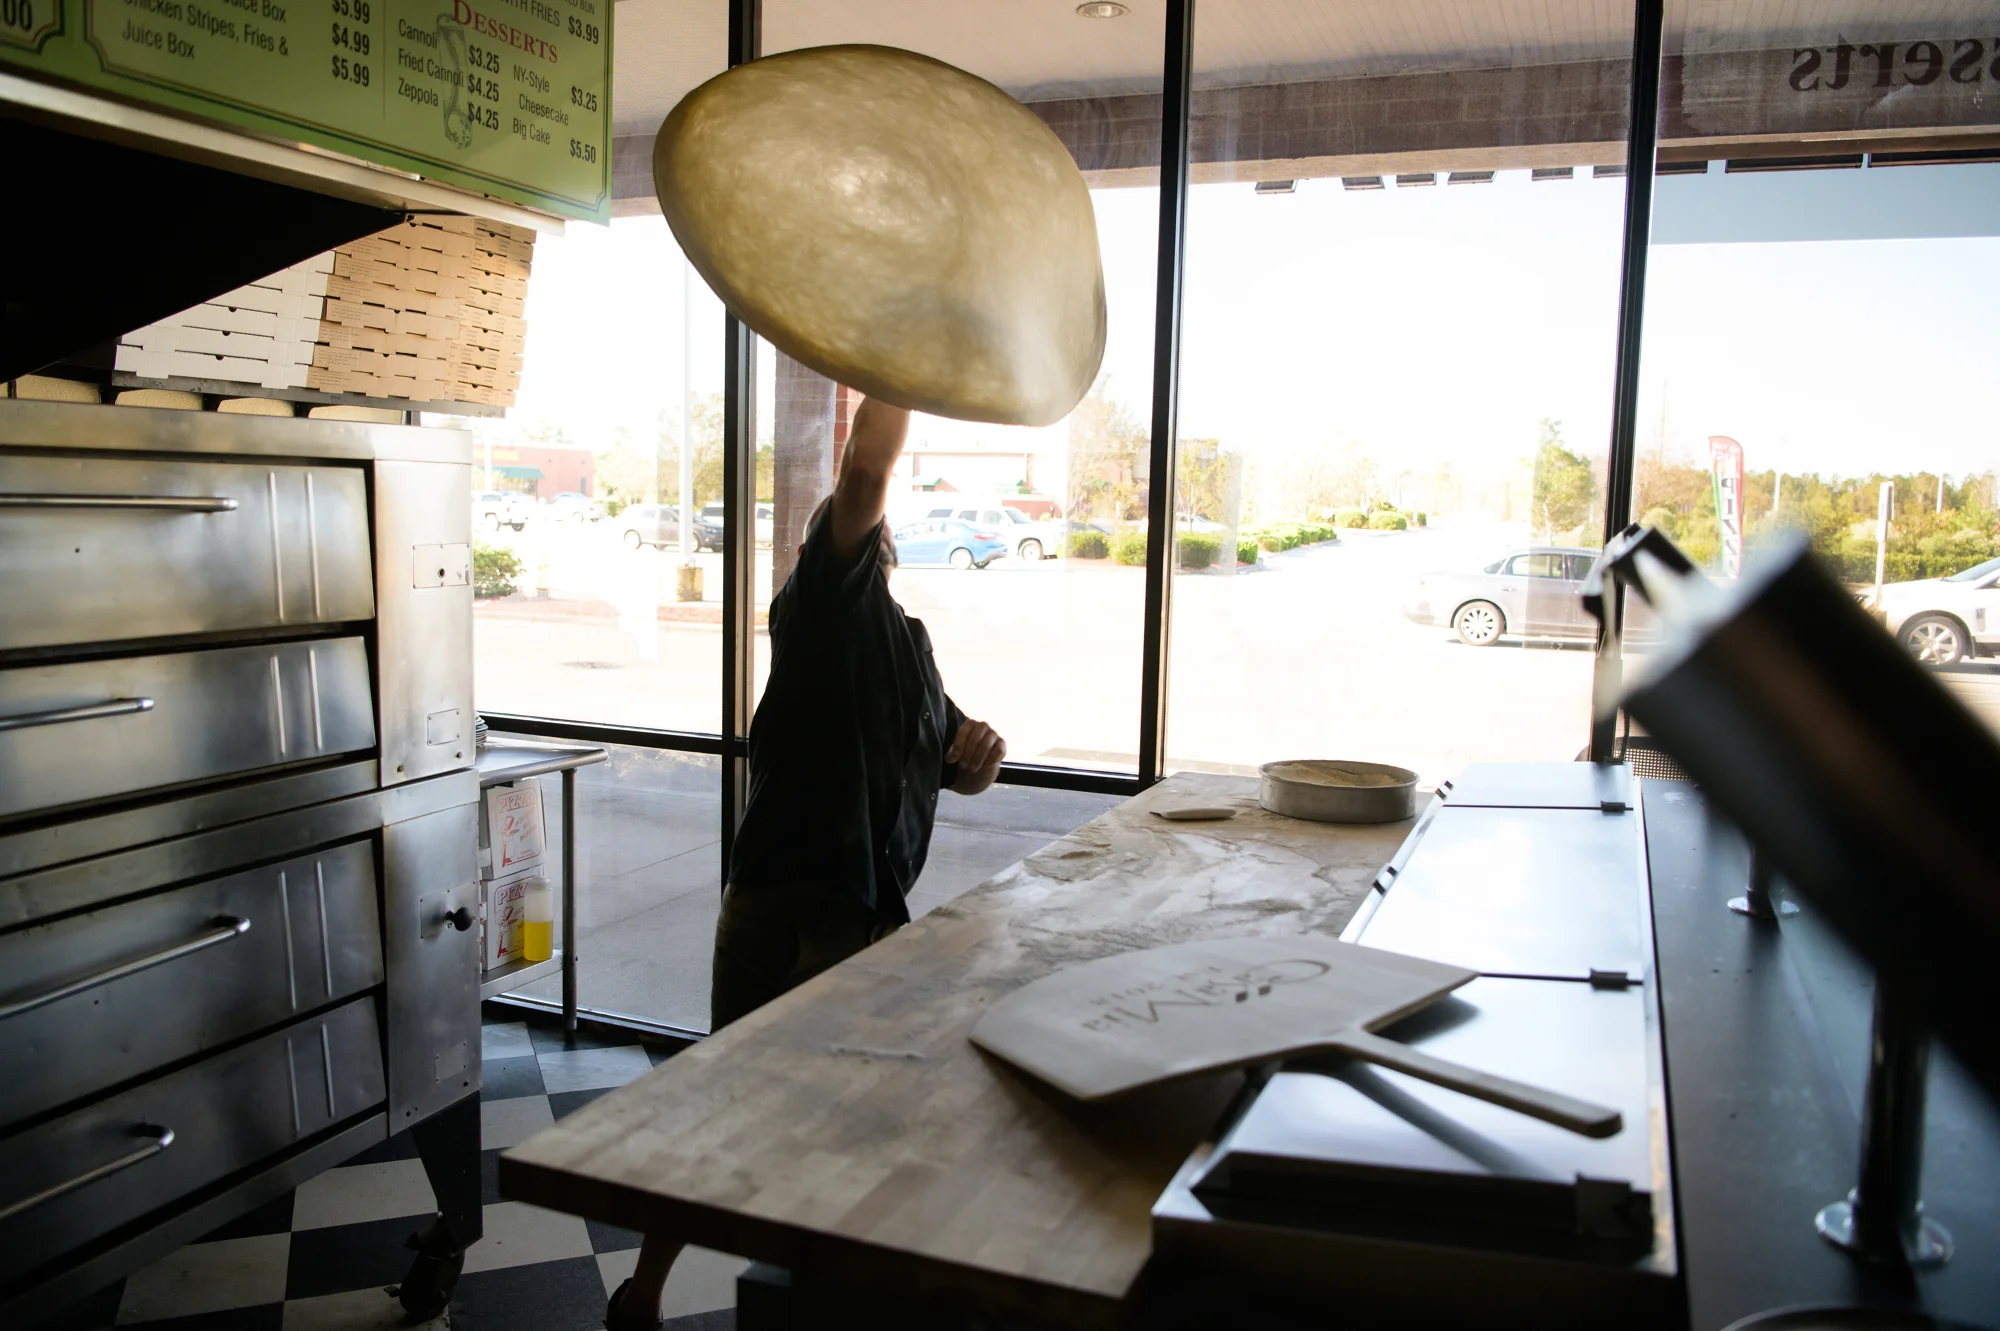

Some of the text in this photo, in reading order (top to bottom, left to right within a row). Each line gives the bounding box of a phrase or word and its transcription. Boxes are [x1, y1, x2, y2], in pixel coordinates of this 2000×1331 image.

[223, 0, 287, 23] ice Box
[332, 0, 370, 24] $5.99
[531, 0, 560, 27] FRIES
[580, 0, 595, 15] BUN
[122, 18, 195, 60] Juice Box
[187, 4, 239, 43] Stripes,
[244, 23, 275, 52] Fries
[279, 36, 288, 56] &
[332, 22, 370, 56] $4.99
[398, 18, 438, 49] Cannoli
[453, 0, 558, 64] DESSERTS
[568, 15, 600, 45] $3.99
[332, 54, 370, 87] $5.99
[398, 48, 464, 88] Fried Cannoli
[469, 44, 500, 74] $3.25
[398, 77, 439, 107] Zeppola
[468, 73, 499, 102] $4.25
[513, 64, 550, 93] NY-Style
[519, 93, 569, 126] Cheesecake
[571, 85, 597, 112] $3.25
[467, 101, 499, 131] $4.25
[513, 117, 551, 145] Big Cake
[570, 138, 597, 164] $5.50
[499, 791, 536, 815] PIZZA
[497, 882, 527, 906] PIZZ
